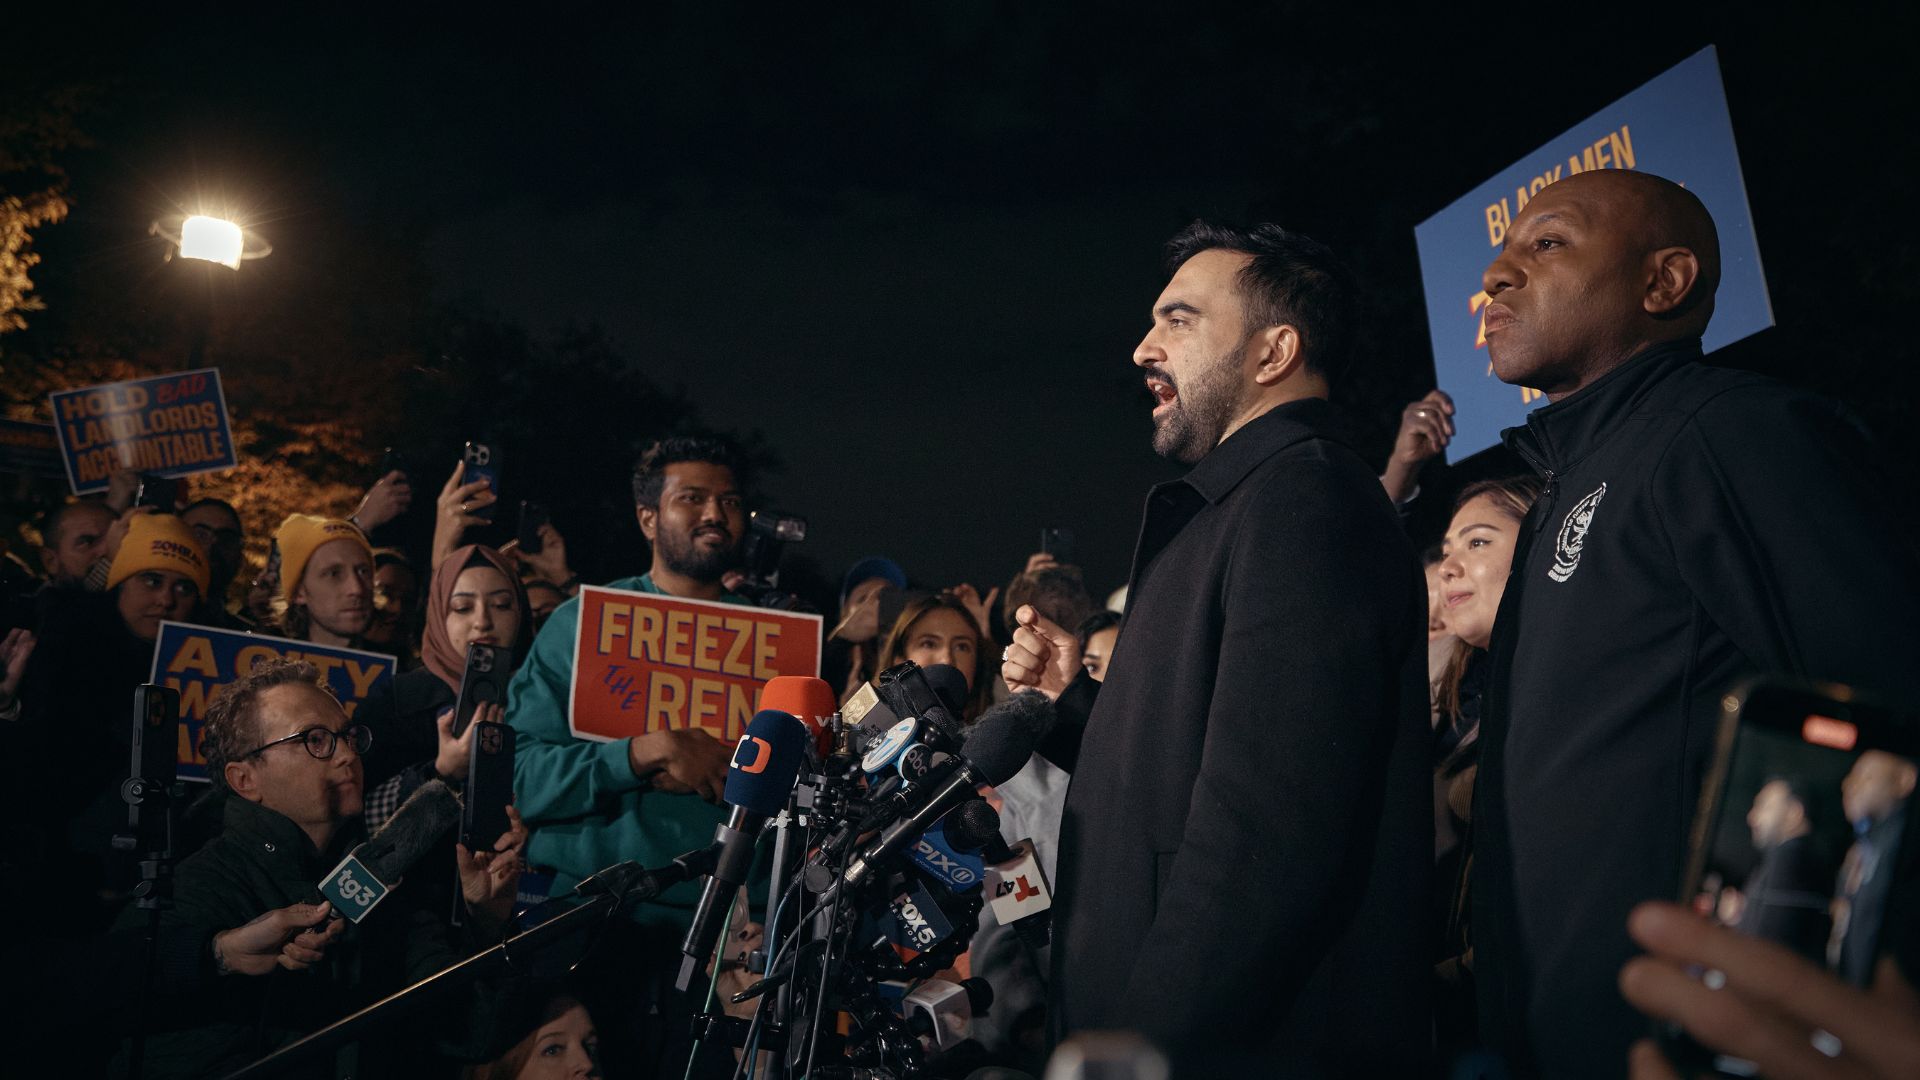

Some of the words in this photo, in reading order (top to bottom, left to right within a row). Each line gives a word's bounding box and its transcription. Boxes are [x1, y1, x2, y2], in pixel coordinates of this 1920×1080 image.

[1568, 124, 1636, 176] MEN
[60, 385, 149, 421] HOLD
[156, 373, 207, 404] BAD
[66, 399, 220, 452] LANDLORDS
[76, 430, 226, 484] ACCOUNTABLE
[598, 601, 781, 680] FREEZE
[165, 635, 220, 679] A
[233, 644, 386, 699] CTY
[604, 664, 642, 710] THE
[644, 671, 763, 743] REN
[906, 748, 928, 777] abc
[337, 868, 377, 907] tg3
[995, 881, 1015, 898] 47
[893, 893, 928, 933] FOX
[917, 927, 937, 944] 5
[903, 923, 923, 949] YORK
